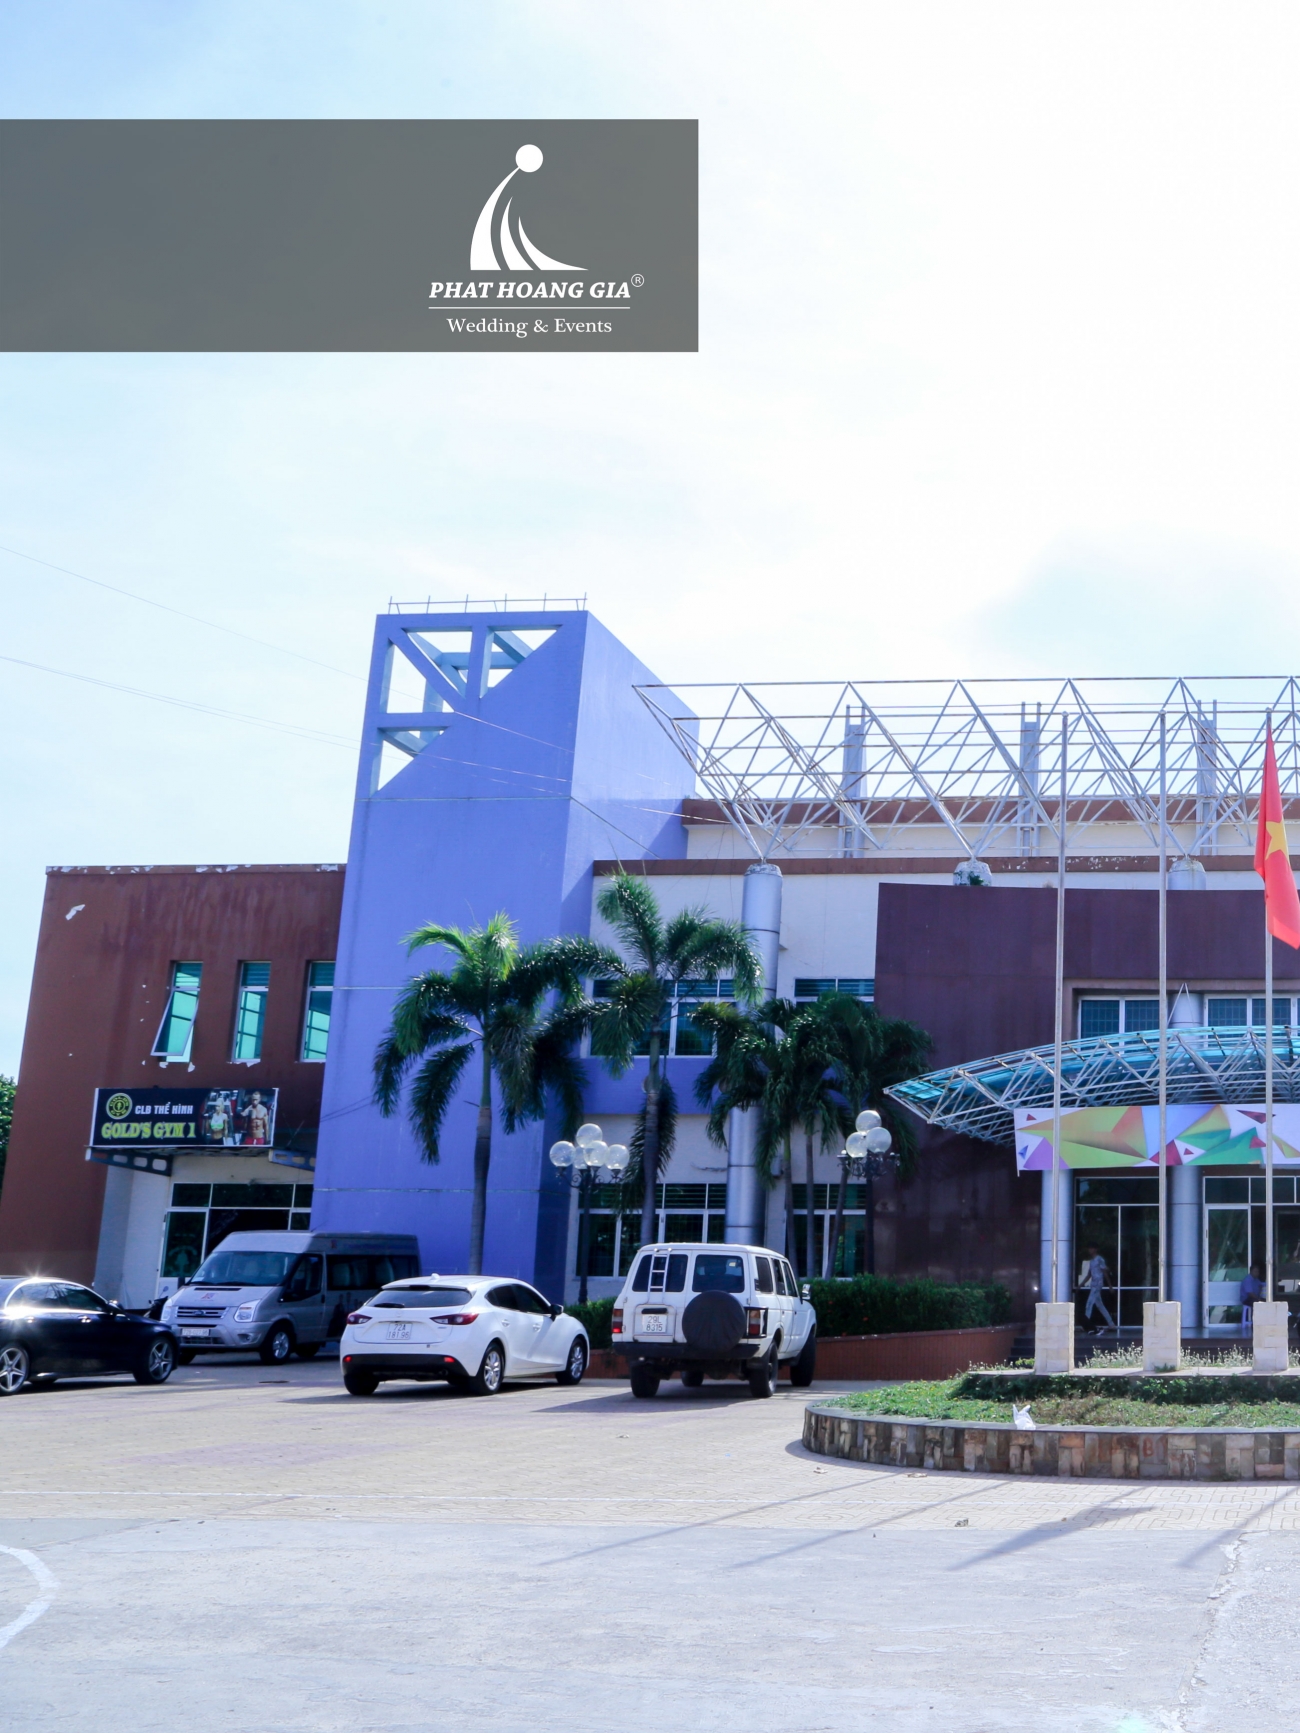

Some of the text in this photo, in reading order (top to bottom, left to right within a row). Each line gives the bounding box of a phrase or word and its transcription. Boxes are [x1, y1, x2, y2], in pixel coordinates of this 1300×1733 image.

[134, 1105, 152, 1115] CLB
[153, 1101, 171, 1115] THỂ
[101, 1121, 152, 1140] GOLD'S
[153, 1121, 186, 1140] GYM
